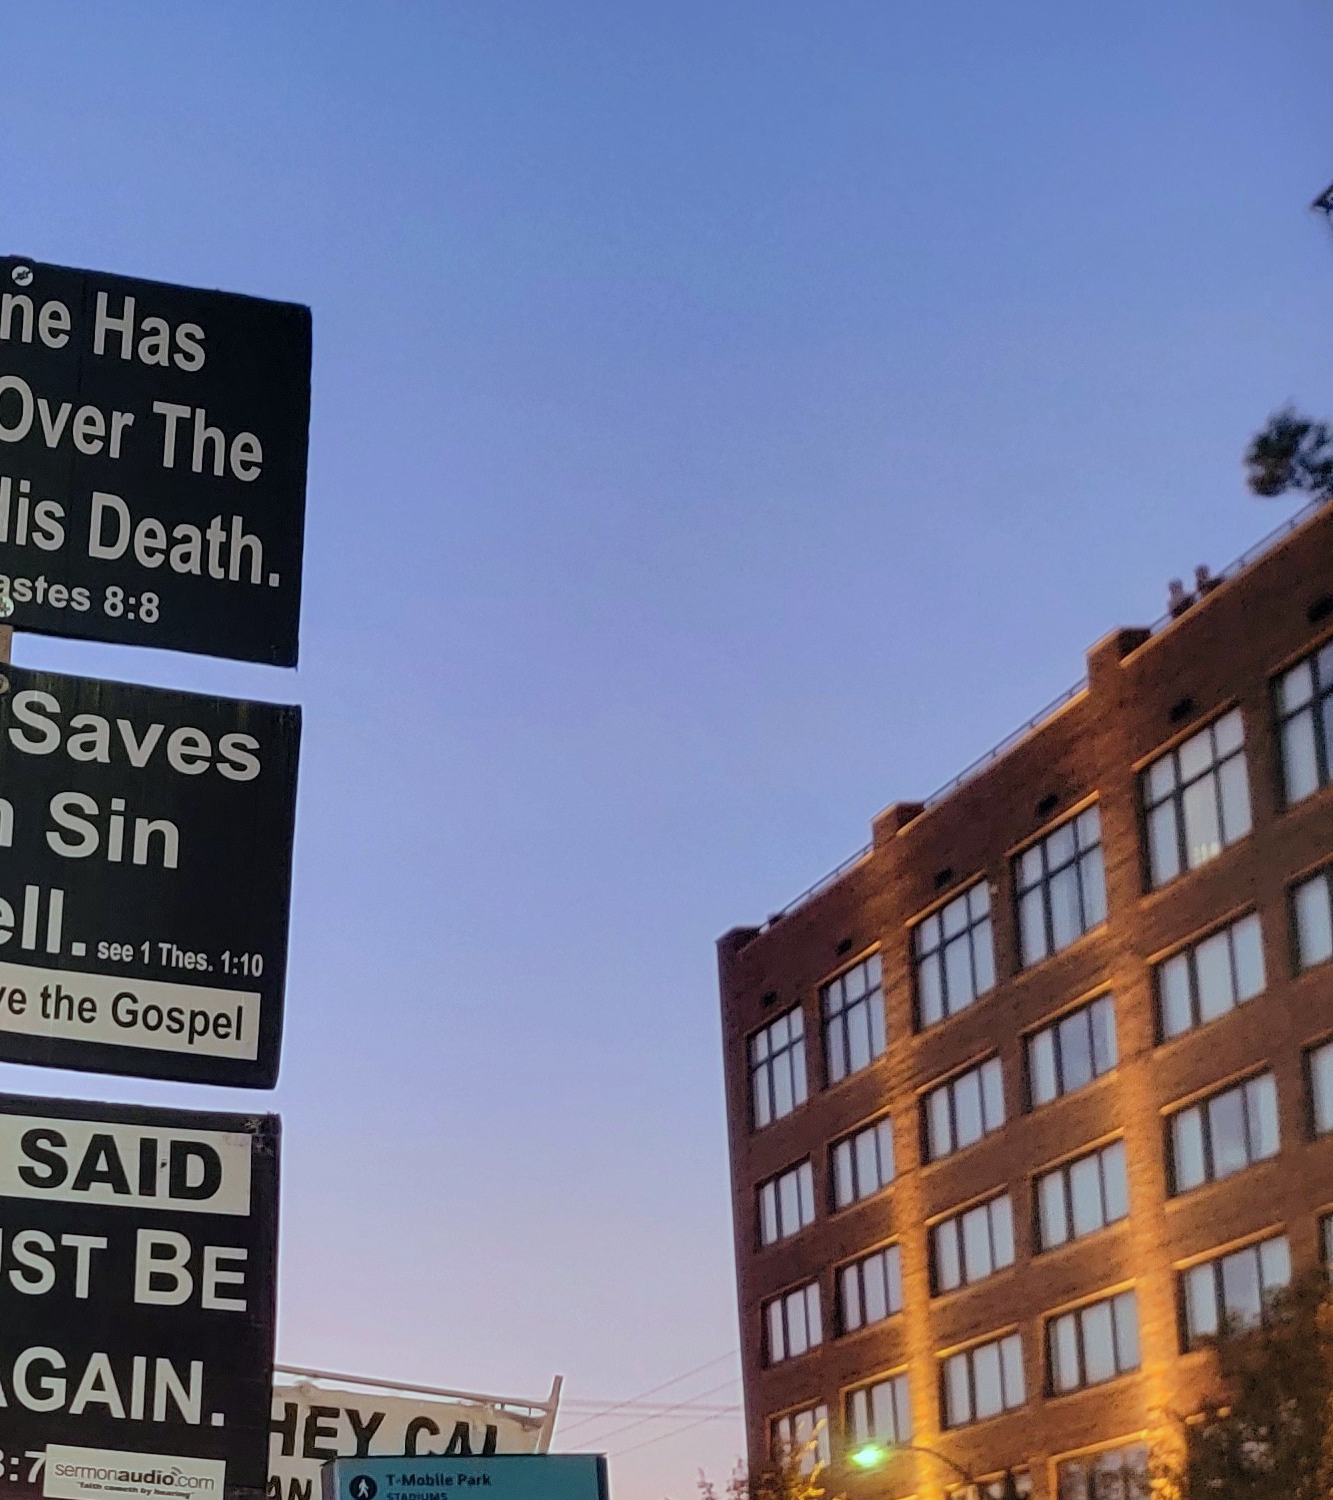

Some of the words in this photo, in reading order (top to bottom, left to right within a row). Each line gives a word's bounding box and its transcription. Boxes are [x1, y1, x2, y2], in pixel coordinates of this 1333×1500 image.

[93, 290, 207, 373] Has
[153, 400, 263, 483] The
[87, 491, 281, 588] Death.
[104, 585, 161, 625] 8:8
[7, 690, 261, 781] Saves
[45, 791, 181, 869] Sin
[97, 939, 134, 963] see
[140, 942, 150, 966] 1
[158, 942, 213, 974] Thes.
[221, 950, 264, 978] 1:10
[39, 984, 97, 1025] the
[111, 993, 244, 1046] Gospel
[18, 1128, 223, 1201] SAID
[134, 1228, 248, 1312] BE
[270, 1402, 386, 1458] HEY
[54, 1463, 215, 1491] sermonaudio.com
[386, 1474, 453, 1487] T-Mobile
[457, 1473, 491, 1487] Park
